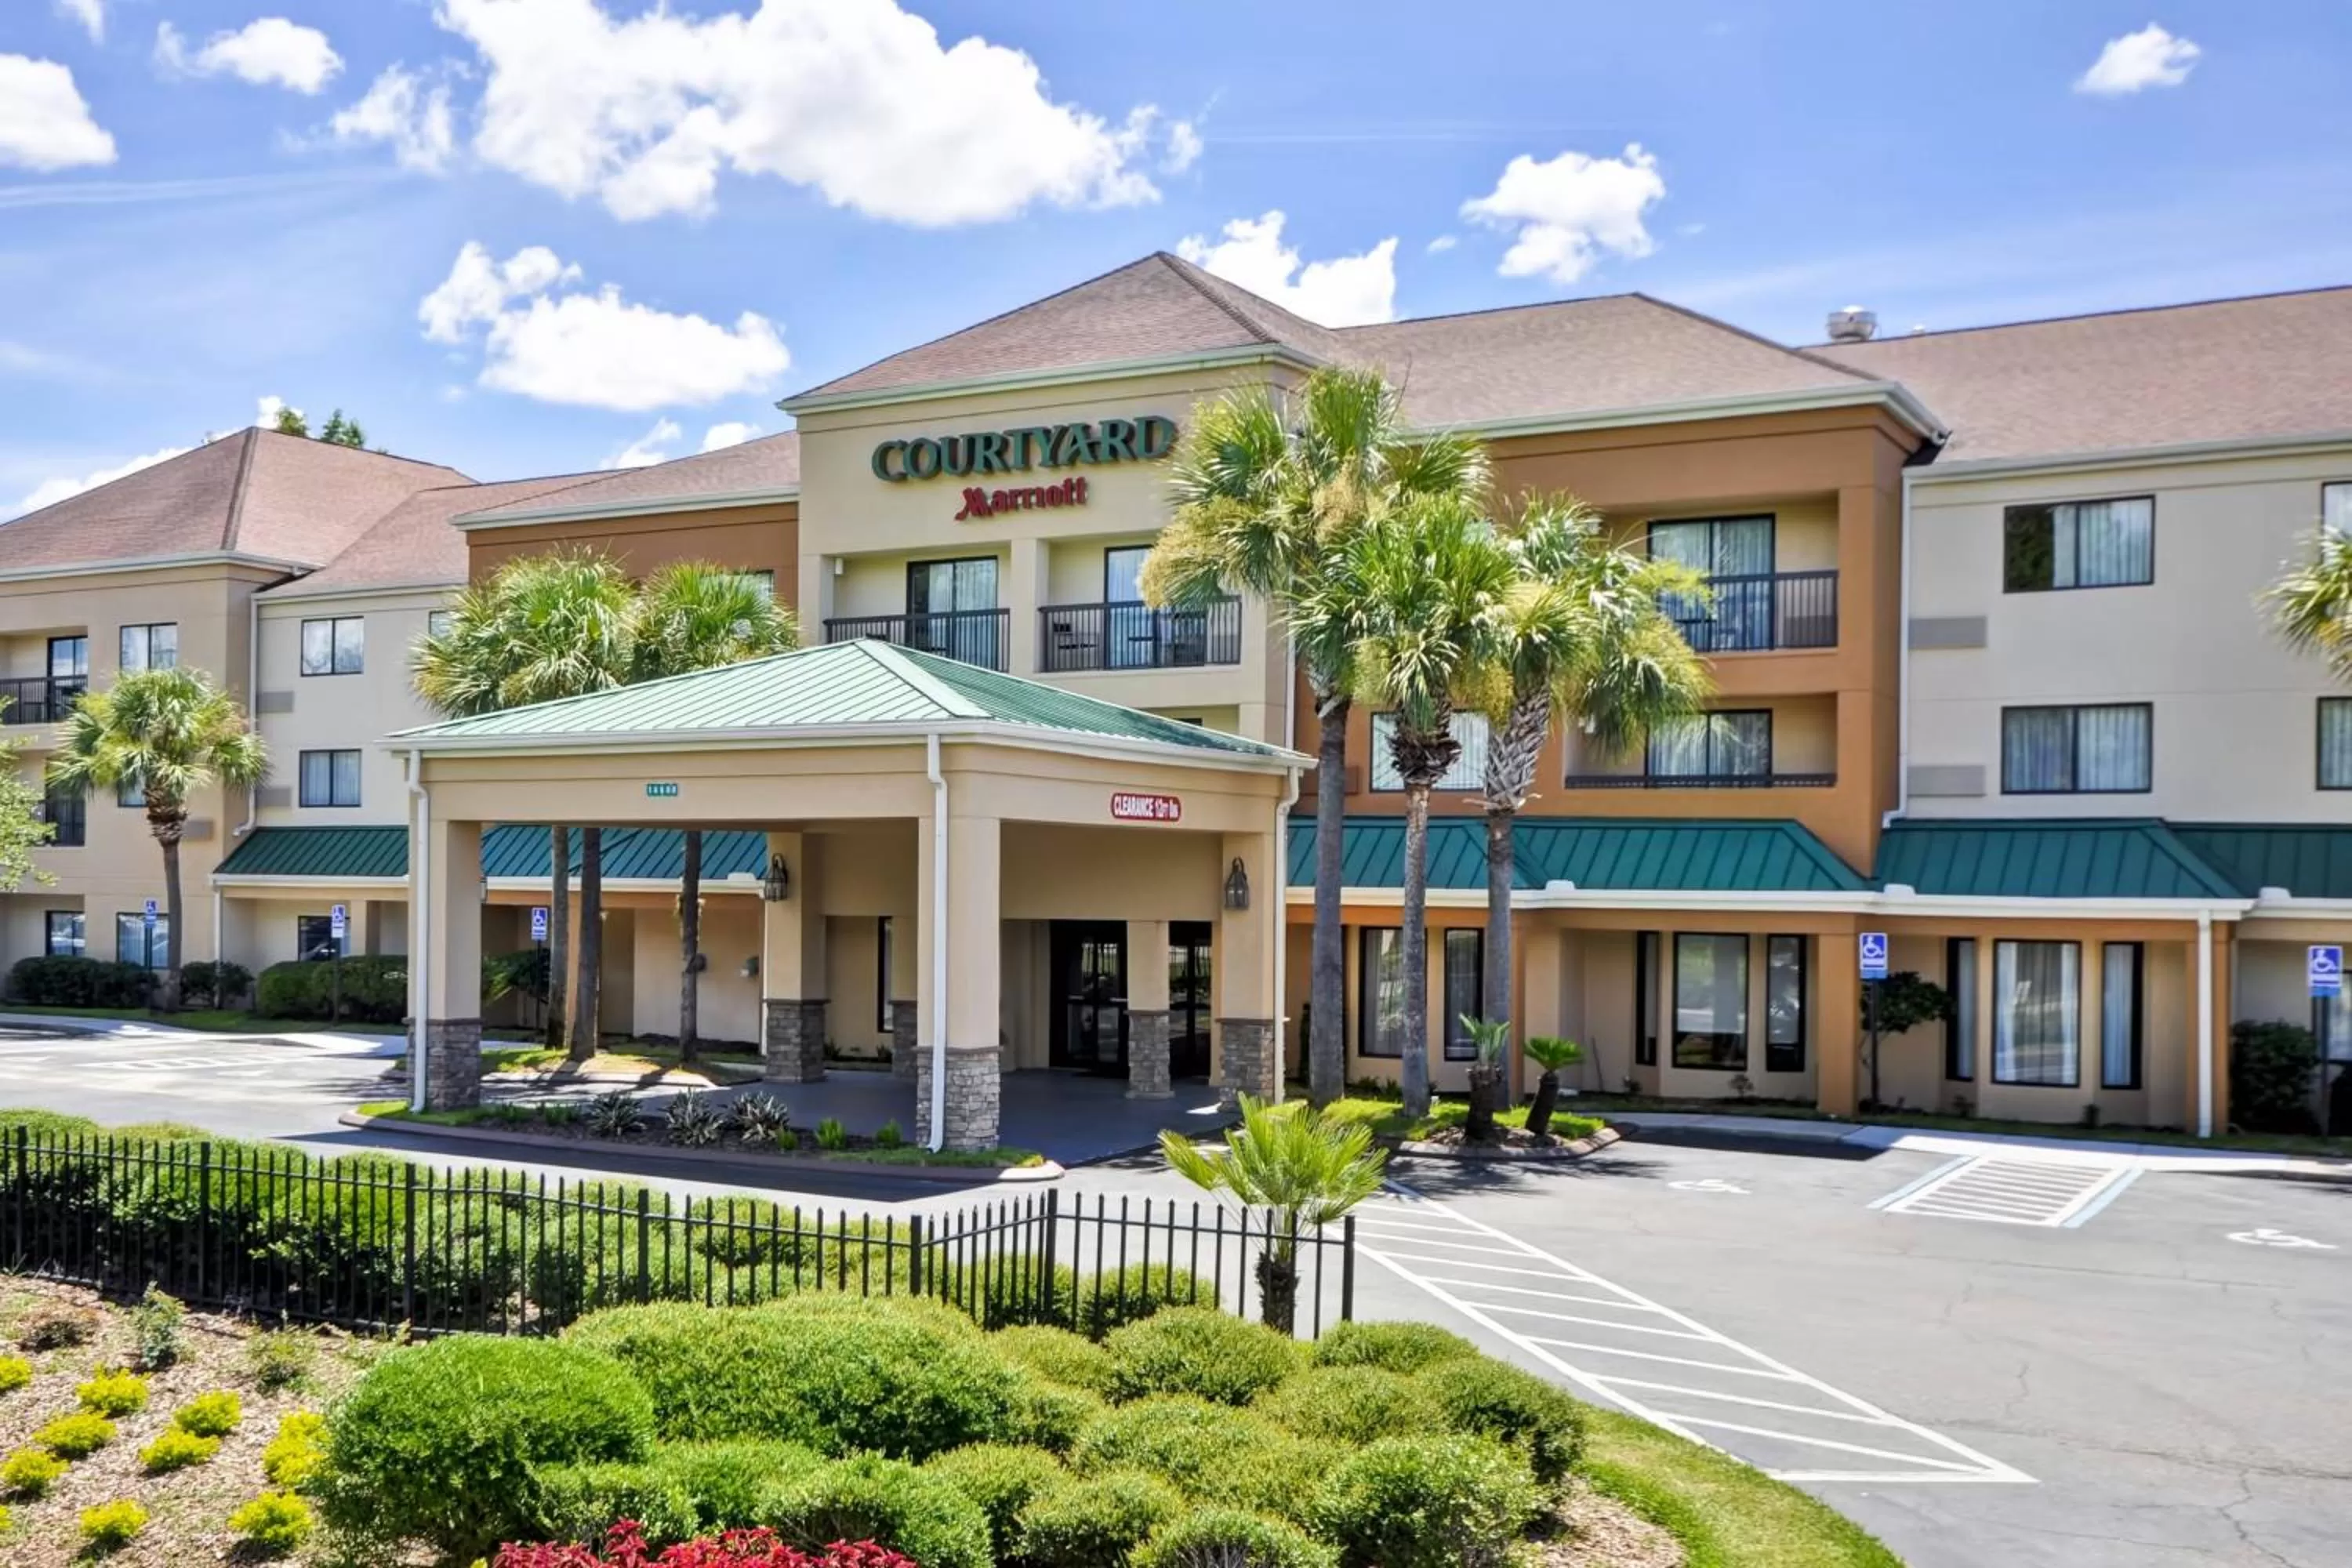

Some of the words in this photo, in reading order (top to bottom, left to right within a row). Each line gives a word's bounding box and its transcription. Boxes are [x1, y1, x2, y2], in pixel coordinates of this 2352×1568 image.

[871, 415, 1178, 483] COURTYARD
[954, 476, 1089, 521] Marriott
[1113, 795, 1154, 818] CLEARANCE
